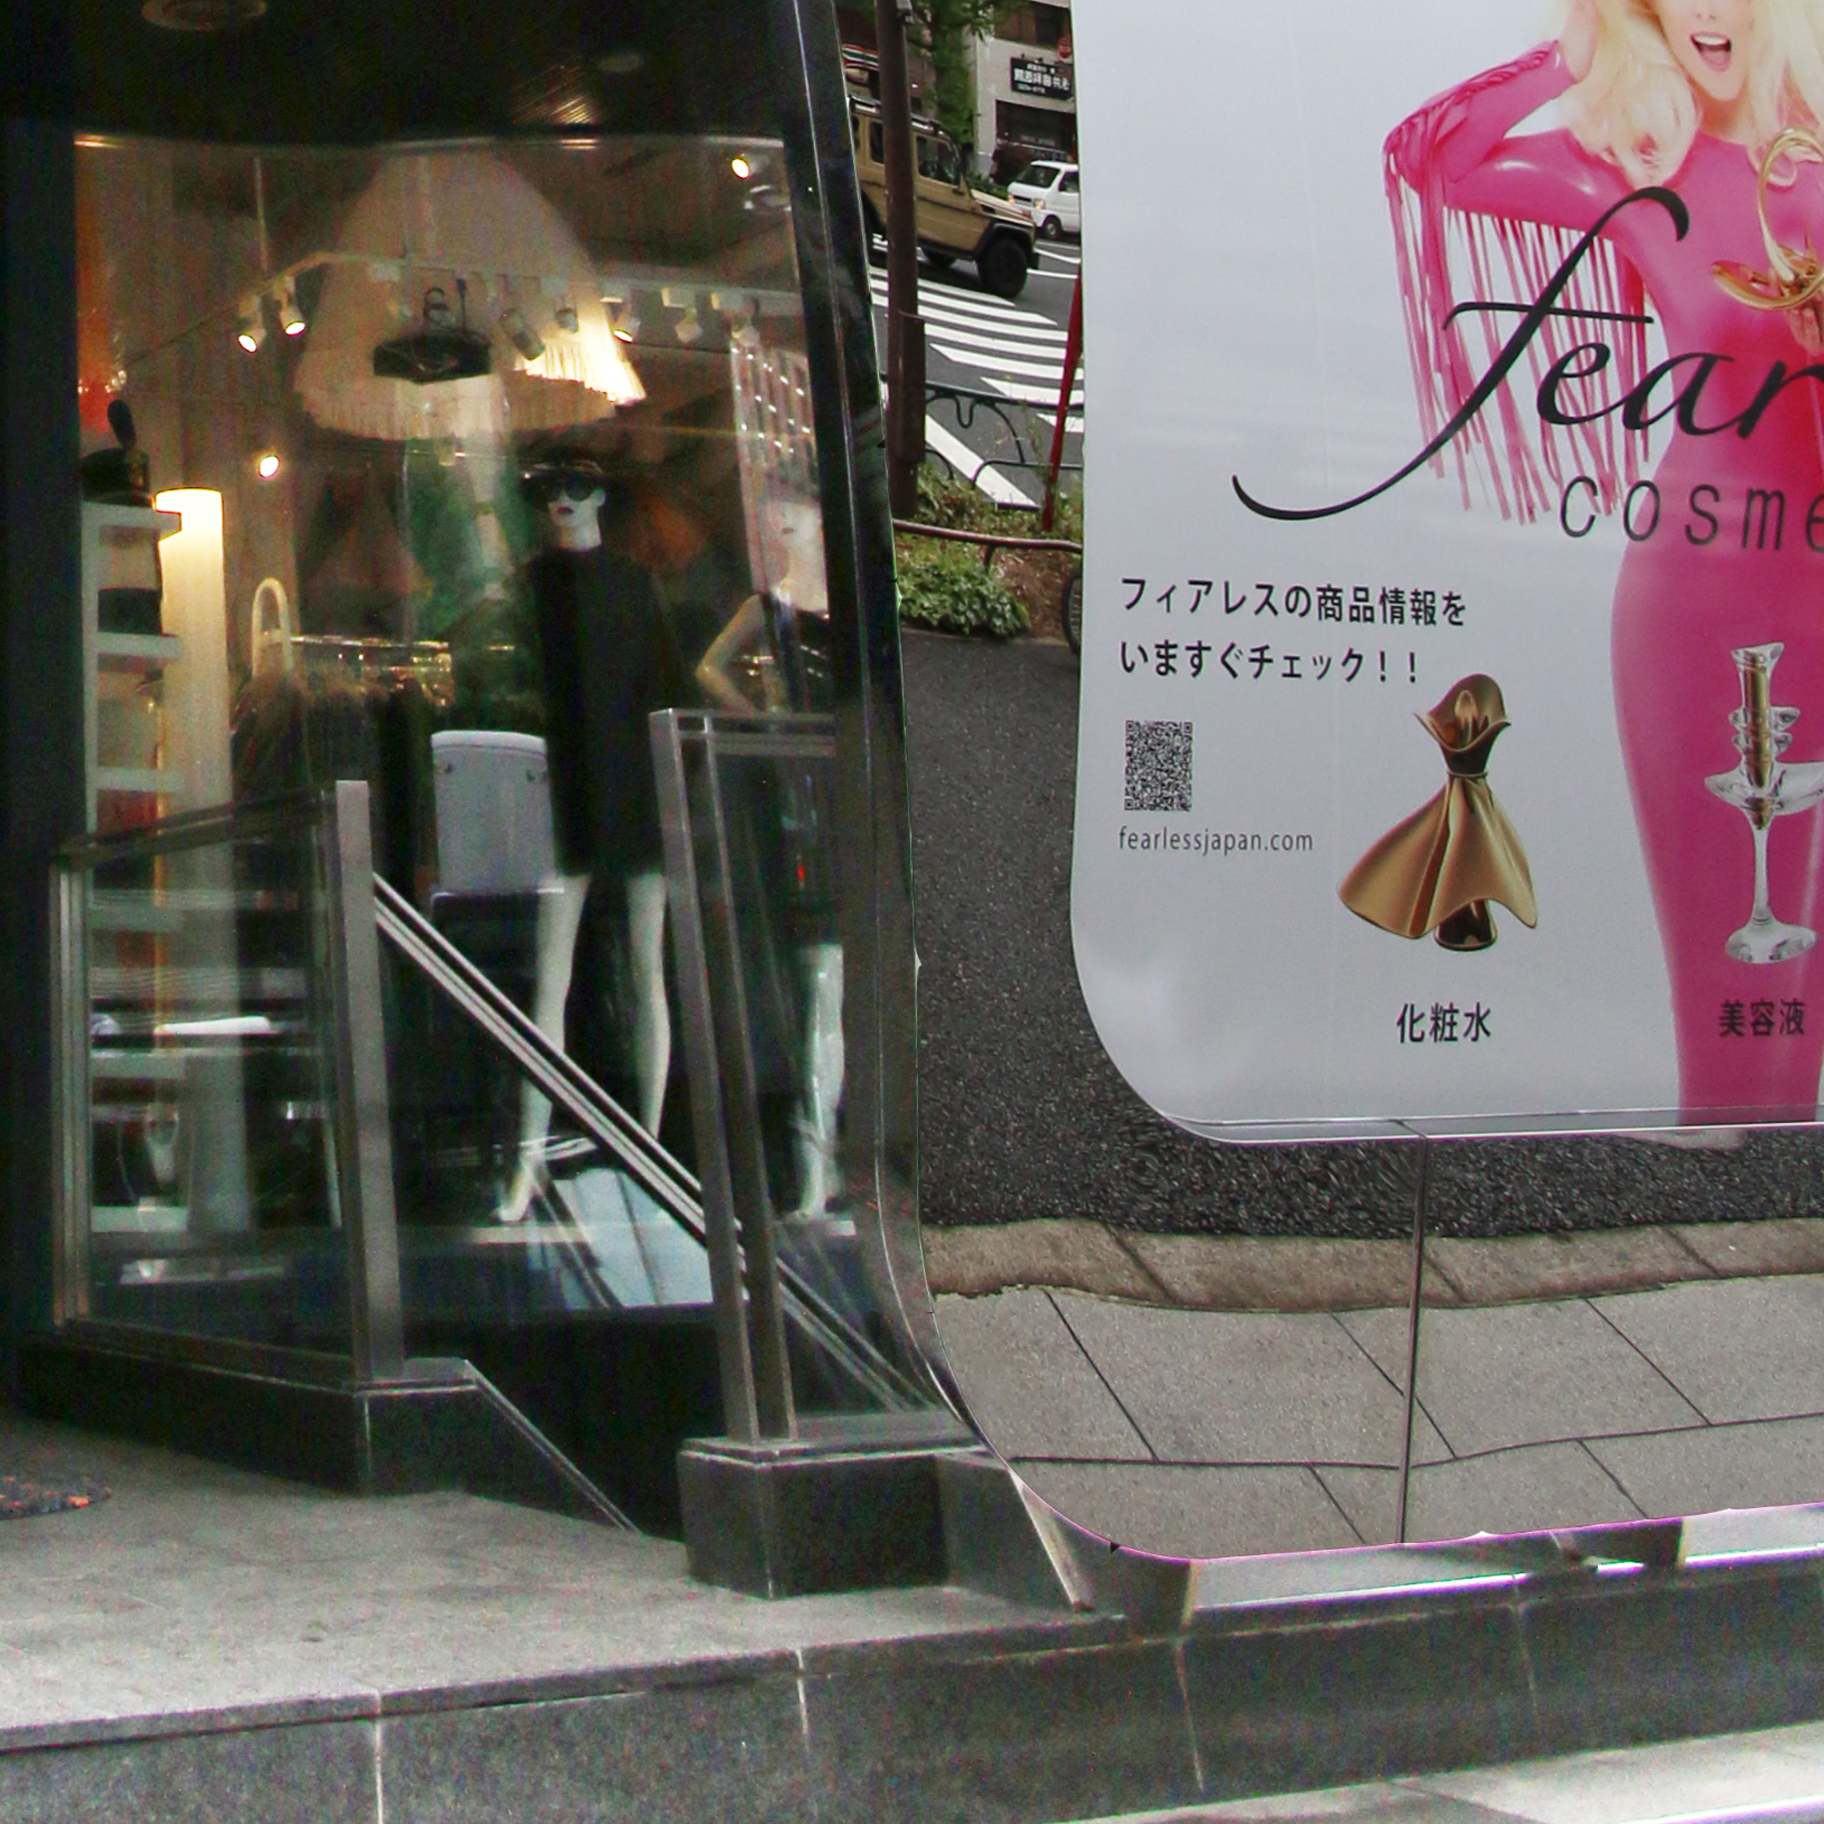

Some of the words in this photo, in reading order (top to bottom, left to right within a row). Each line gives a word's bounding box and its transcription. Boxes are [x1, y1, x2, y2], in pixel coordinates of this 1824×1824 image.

[1121, 577, 1467, 627] フィアレスの商品情報を
[1119, 825, 1314, 856] fearlessjapan.com
[1396, 1000, 1493, 1047] 化粧水
[1717, 998, 1806, 1038] 美容液
